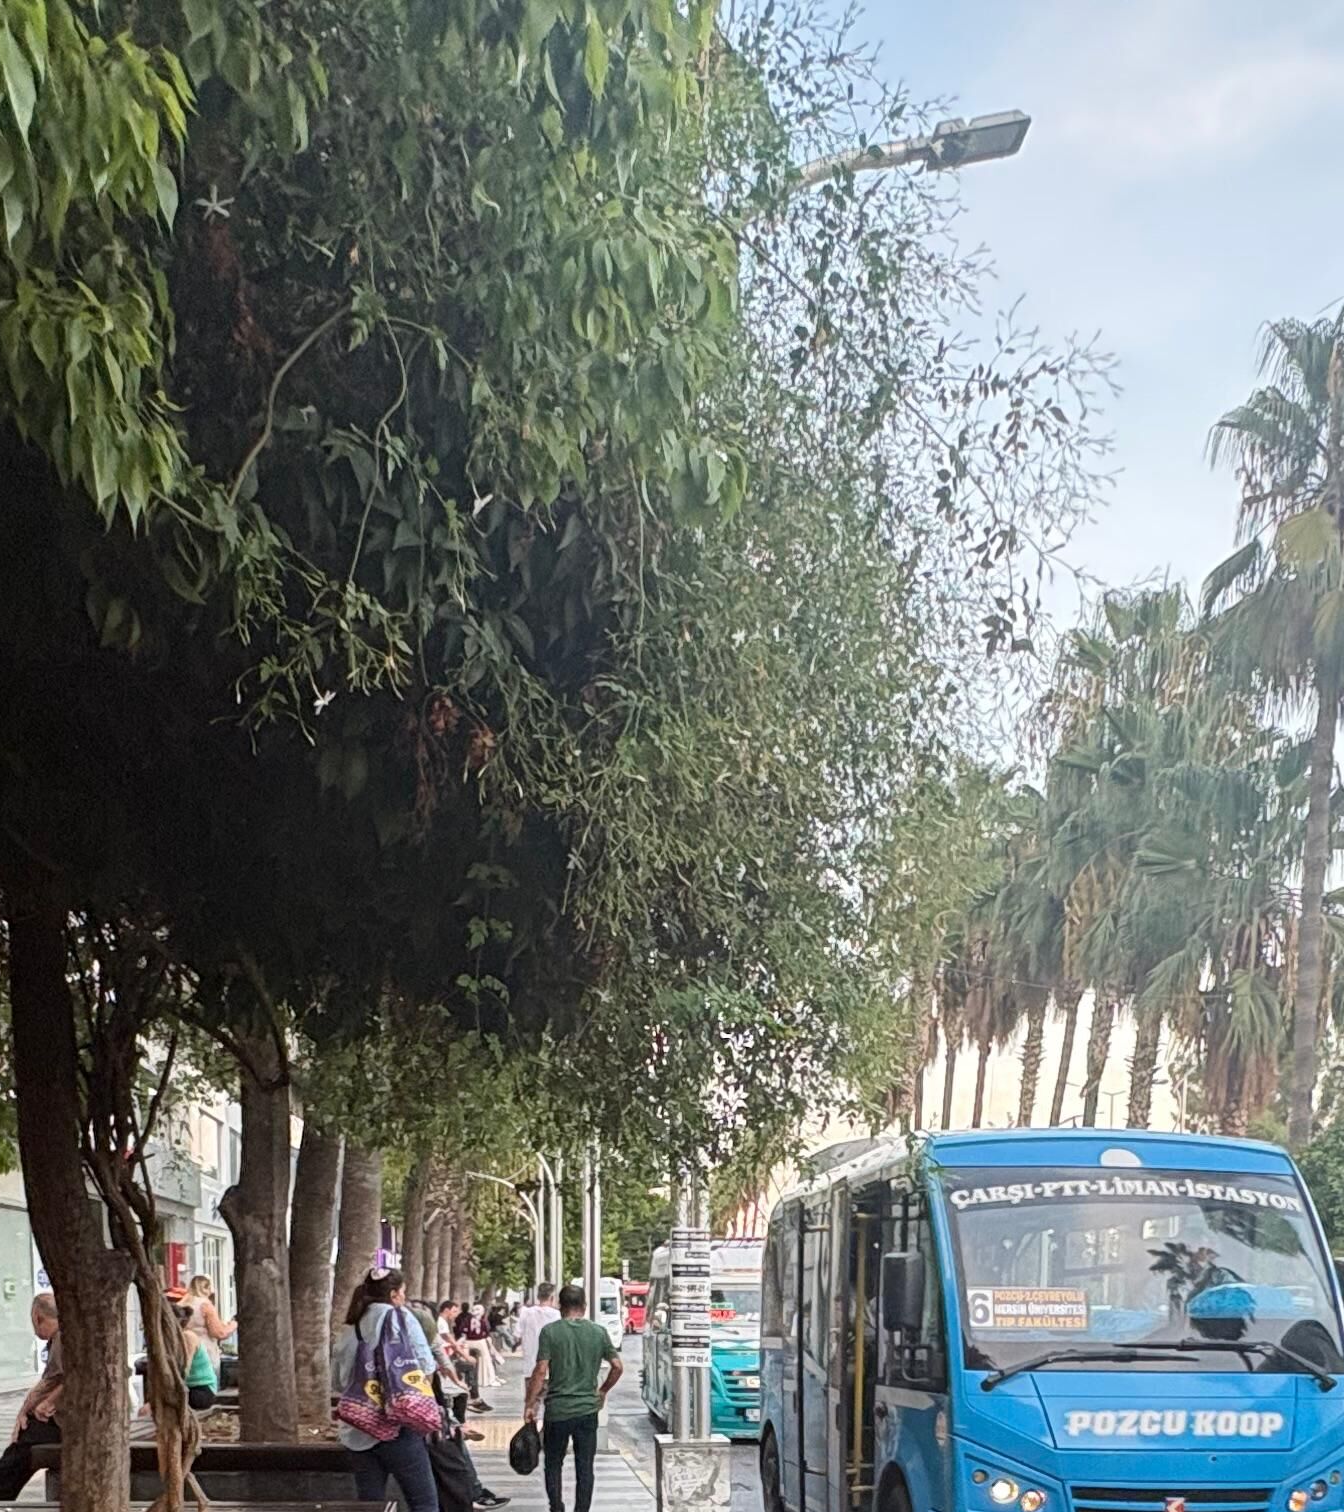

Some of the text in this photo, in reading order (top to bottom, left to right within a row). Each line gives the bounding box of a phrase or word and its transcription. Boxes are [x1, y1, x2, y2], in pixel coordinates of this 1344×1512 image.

[971, 1293, 990, 1324] 6
[1064, 1409, 1284, 1438] POZCU KOOP
